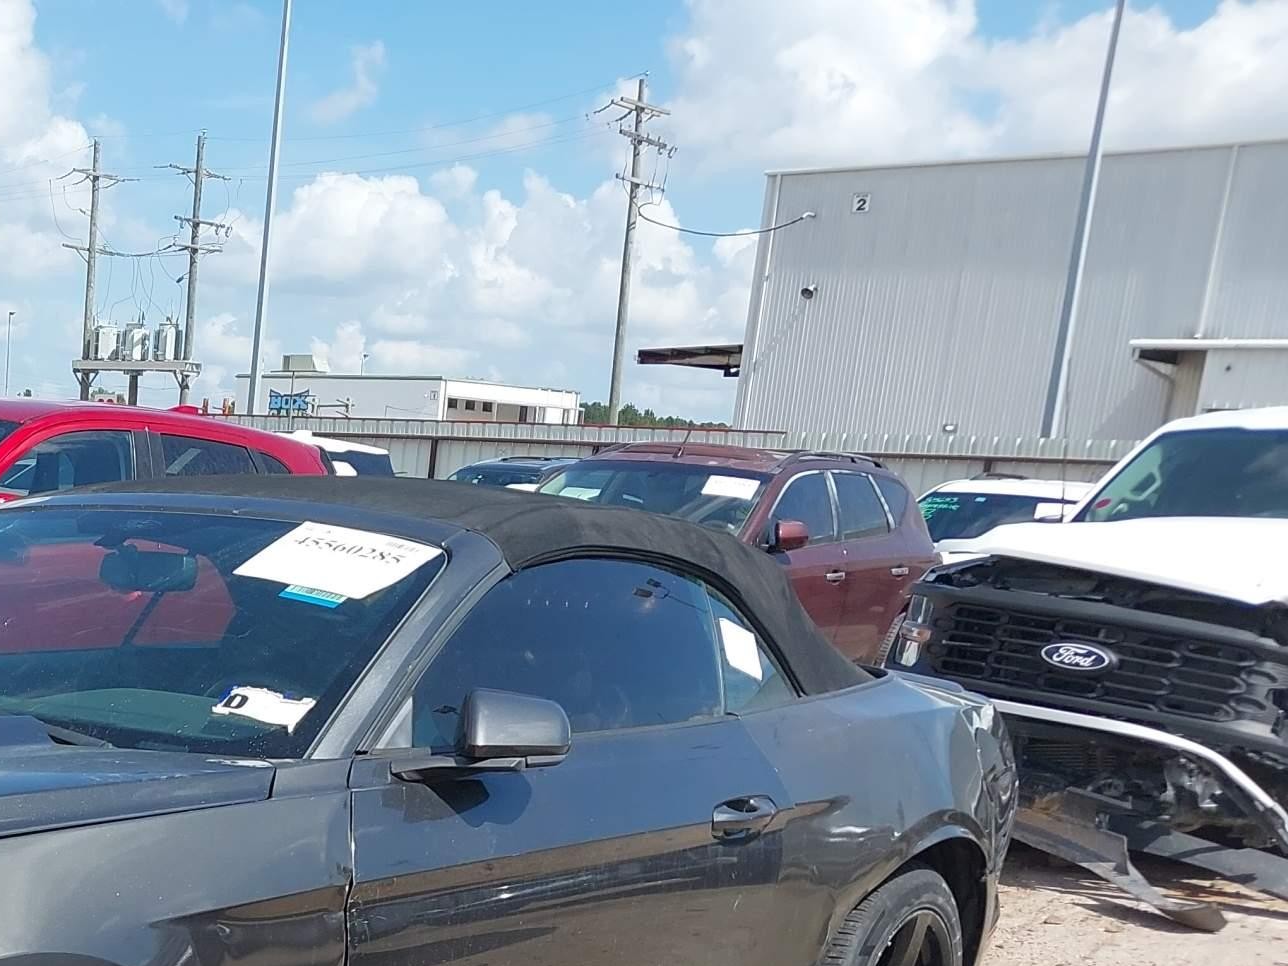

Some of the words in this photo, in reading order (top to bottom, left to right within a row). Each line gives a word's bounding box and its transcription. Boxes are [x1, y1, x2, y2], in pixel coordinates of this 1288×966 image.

[855, 198, 867, 211] 2
[269, 395, 308, 411] BOX
[294, 535, 407, 564] 45560285
[1052, 646, 1097, 667] Ford
[222, 693, 249, 709] D
